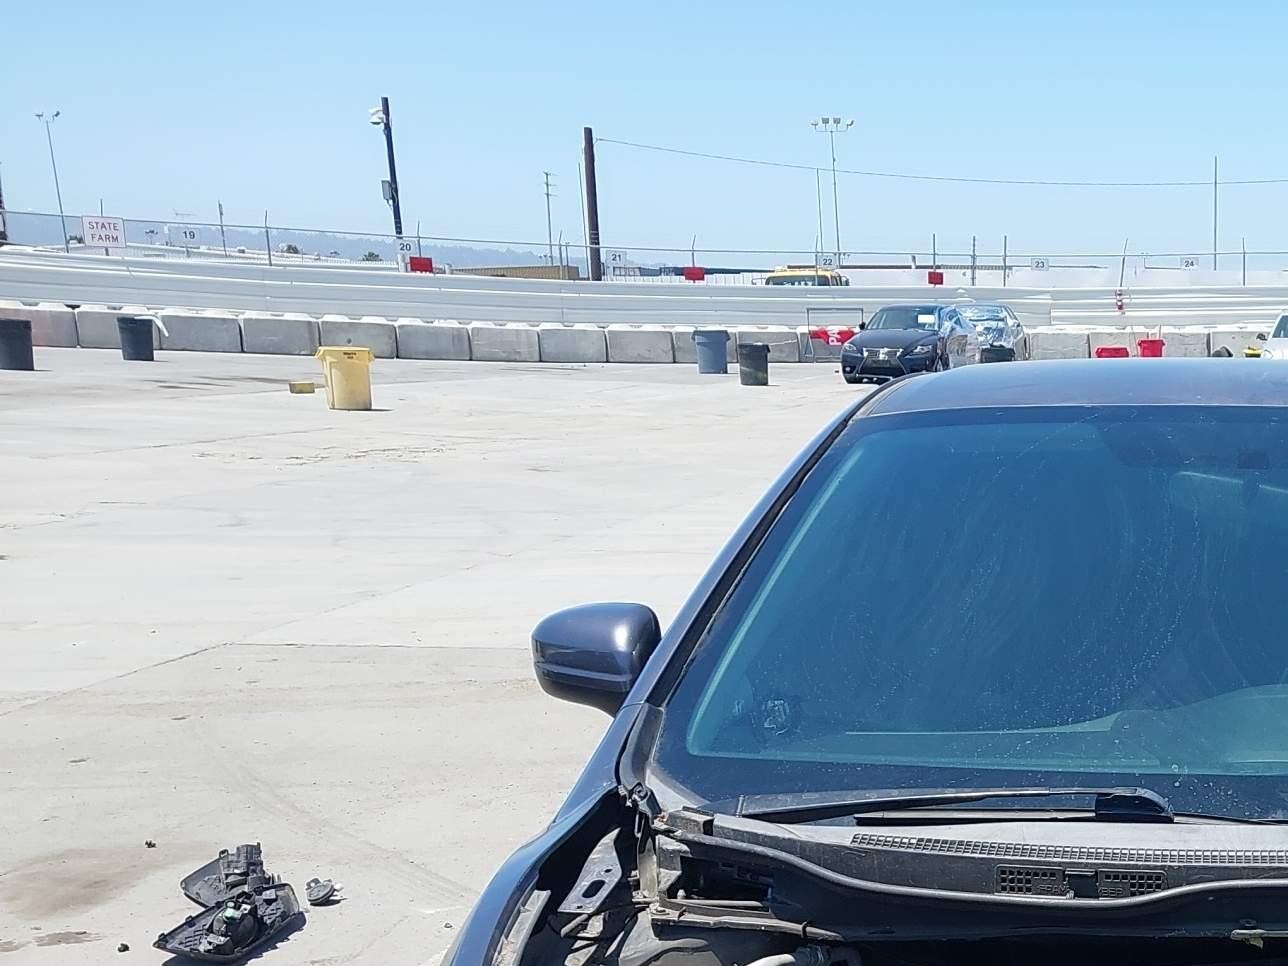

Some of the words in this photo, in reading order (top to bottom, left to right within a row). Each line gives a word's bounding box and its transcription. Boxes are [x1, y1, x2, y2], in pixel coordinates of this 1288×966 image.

[88, 221, 119, 231] STATE
[91, 233, 119, 243] FARM
[183, 231, 196, 240] 19
[399, 243, 412, 252] 20
[611, 253, 622, 262] 21
[822, 258, 833, 266] 22
[1034, 261, 1045, 269] 23
[1184, 260, 1195, 269] 24
